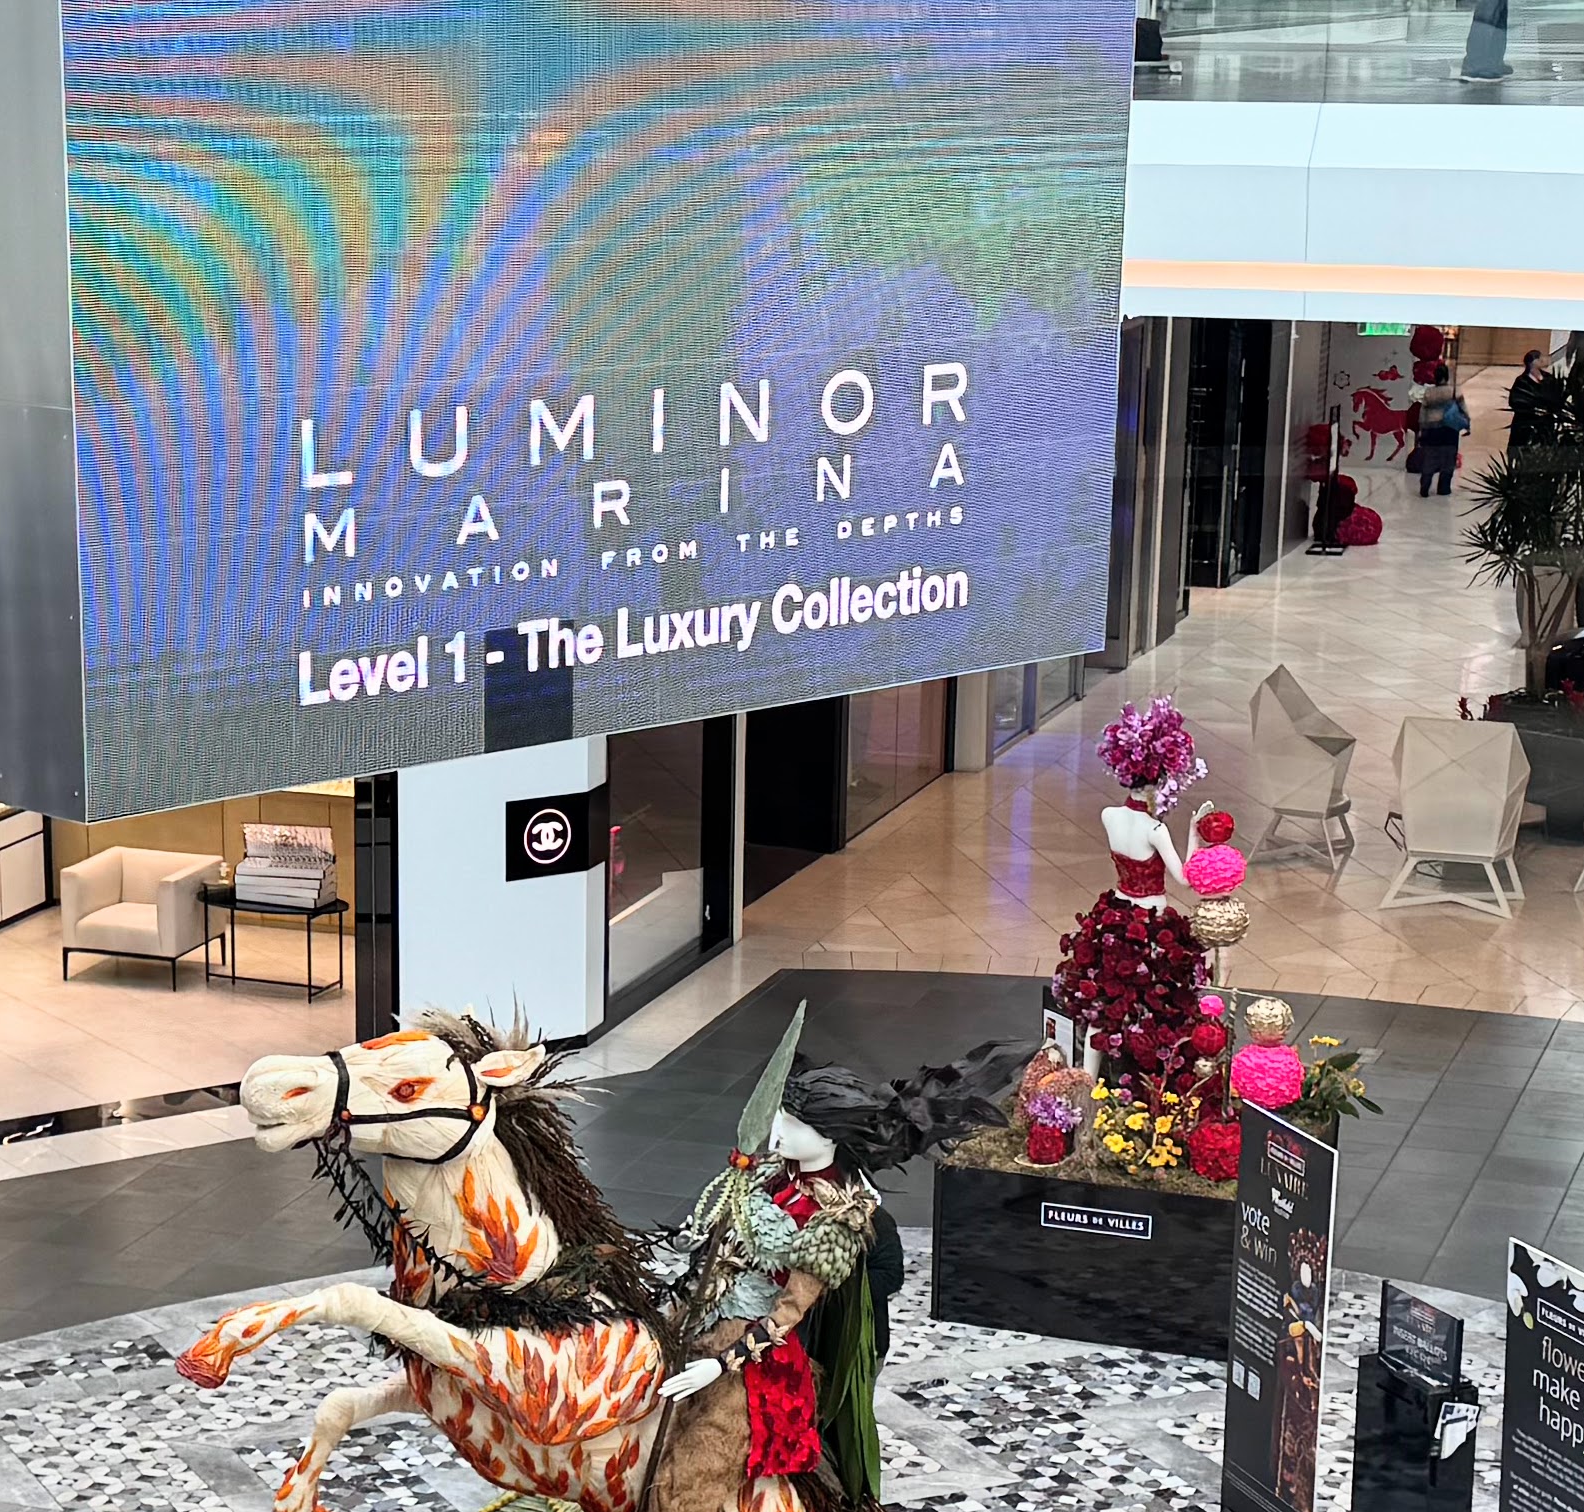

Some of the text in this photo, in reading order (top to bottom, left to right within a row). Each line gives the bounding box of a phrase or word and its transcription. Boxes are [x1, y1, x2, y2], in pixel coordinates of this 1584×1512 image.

[301, 362, 967, 487] LUMINOR
[304, 443, 964, 563] MARINA
[303, 506, 964, 608] INNOVATION FROM THE DEPTHS
[299, 565, 968, 706] Level 1 - The Luxury Collection
[1048, 1210, 1088, 1224] FLEURS
[1107, 1217, 1144, 1231] VILLES
[1241, 1201, 1270, 1236] vote
[1241, 1225, 1277, 1267] & win
[1541, 1307, 1567, 1328] FLEURS
[1533, 1368, 1581, 1411] make
